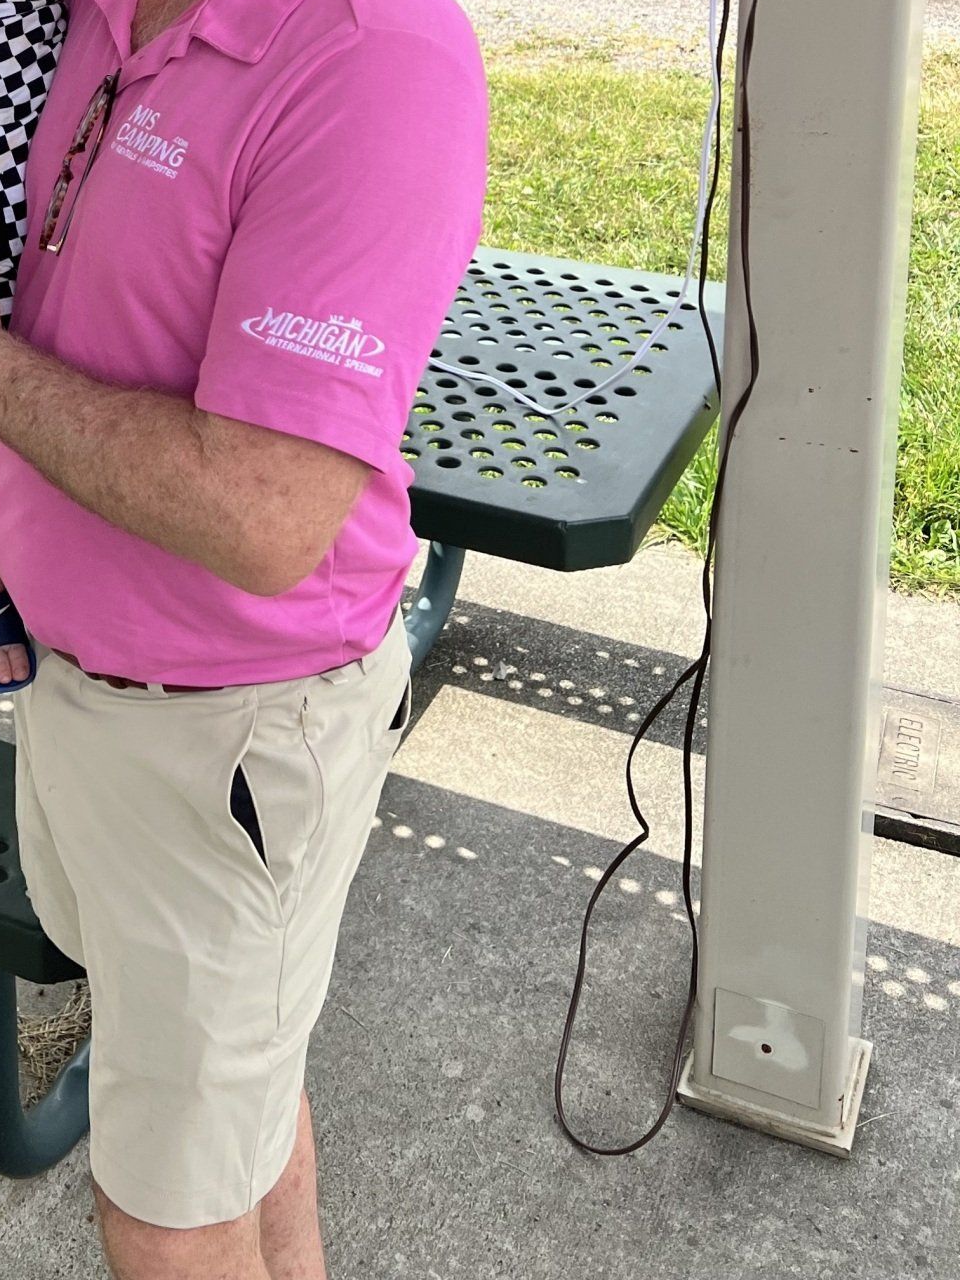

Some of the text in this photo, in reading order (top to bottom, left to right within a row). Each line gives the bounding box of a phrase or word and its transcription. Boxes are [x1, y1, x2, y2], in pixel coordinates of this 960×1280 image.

[128, 105, 160, 131] MIS
[117, 123, 187, 167] CAMPING
[255, 306, 368, 358] MICHIGAN
[265, 336, 384, 378] INTERNATIONAL SPEEDWAY
[892, 717, 923, 780] ELECTRIC
